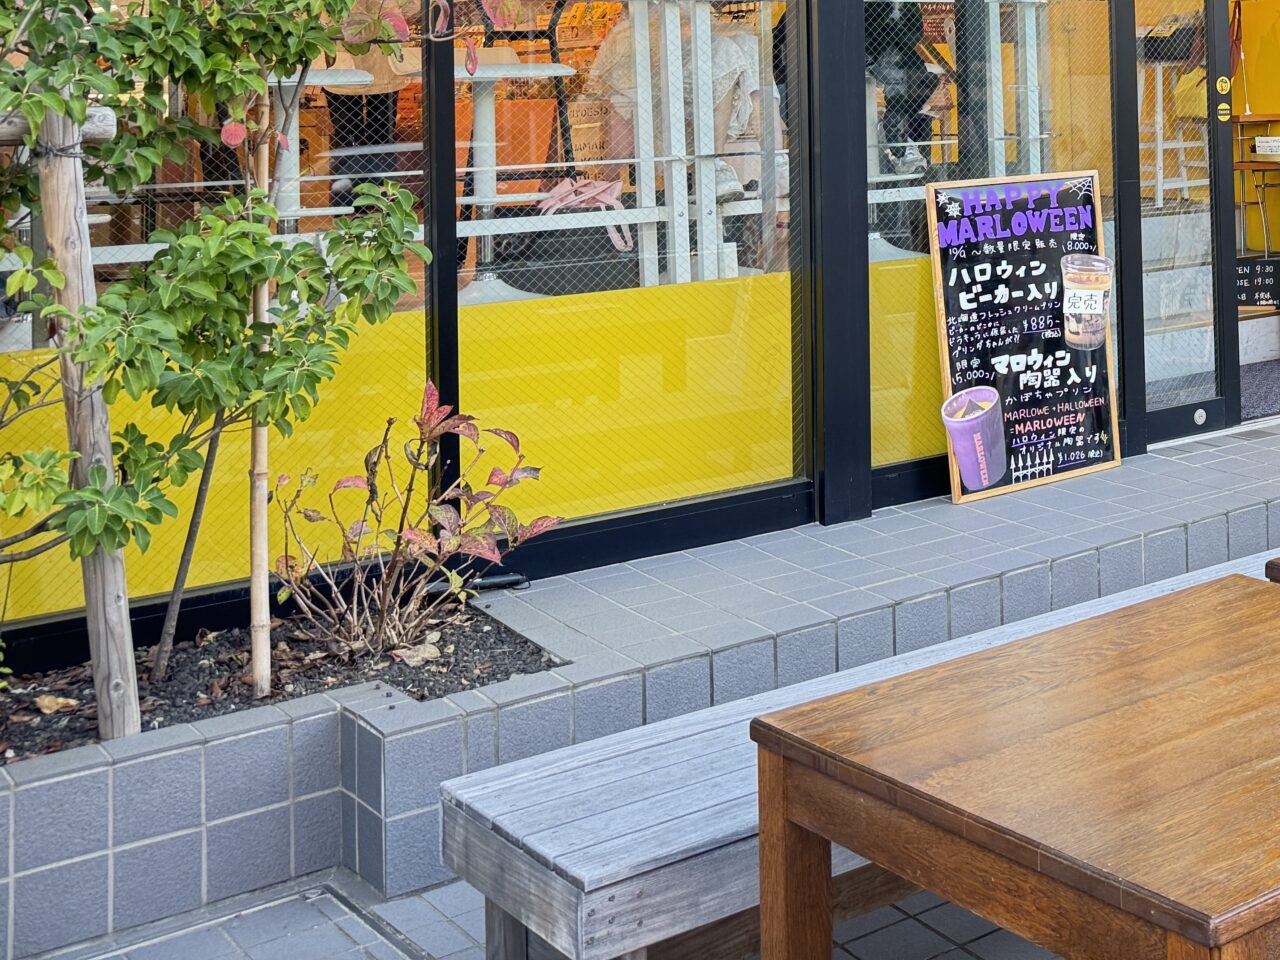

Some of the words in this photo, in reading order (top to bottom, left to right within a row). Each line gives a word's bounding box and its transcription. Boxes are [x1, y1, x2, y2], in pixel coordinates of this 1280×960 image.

[961, 181, 1065, 217] HAPPY
[937, 205, 1093, 248] MARLOWEEN
[948, 260, 1047, 287] ハロウィン
[1254, 277, 1274, 286] 19:00
[1255, 265, 1274, 274] 9:30
[958, 281, 1058, 310] ビーカー入り
[1067, 292, 1098, 311] 完売
[947, 300, 1061, 325] 北海道フレッシュクリームプリン
[955, 358, 981, 372] 限定
[990, 348, 1071, 375] マロウィン
[1019, 364, 1097, 390] 陶器入り
[1005, 387, 1092, 406] かぼちゃプリン
[1004, 405, 1050, 423] MARLOWE
[1056, 396, 1105, 413] HALLOWEEN
[1012, 427, 1085, 445] ハロウィン限定の
